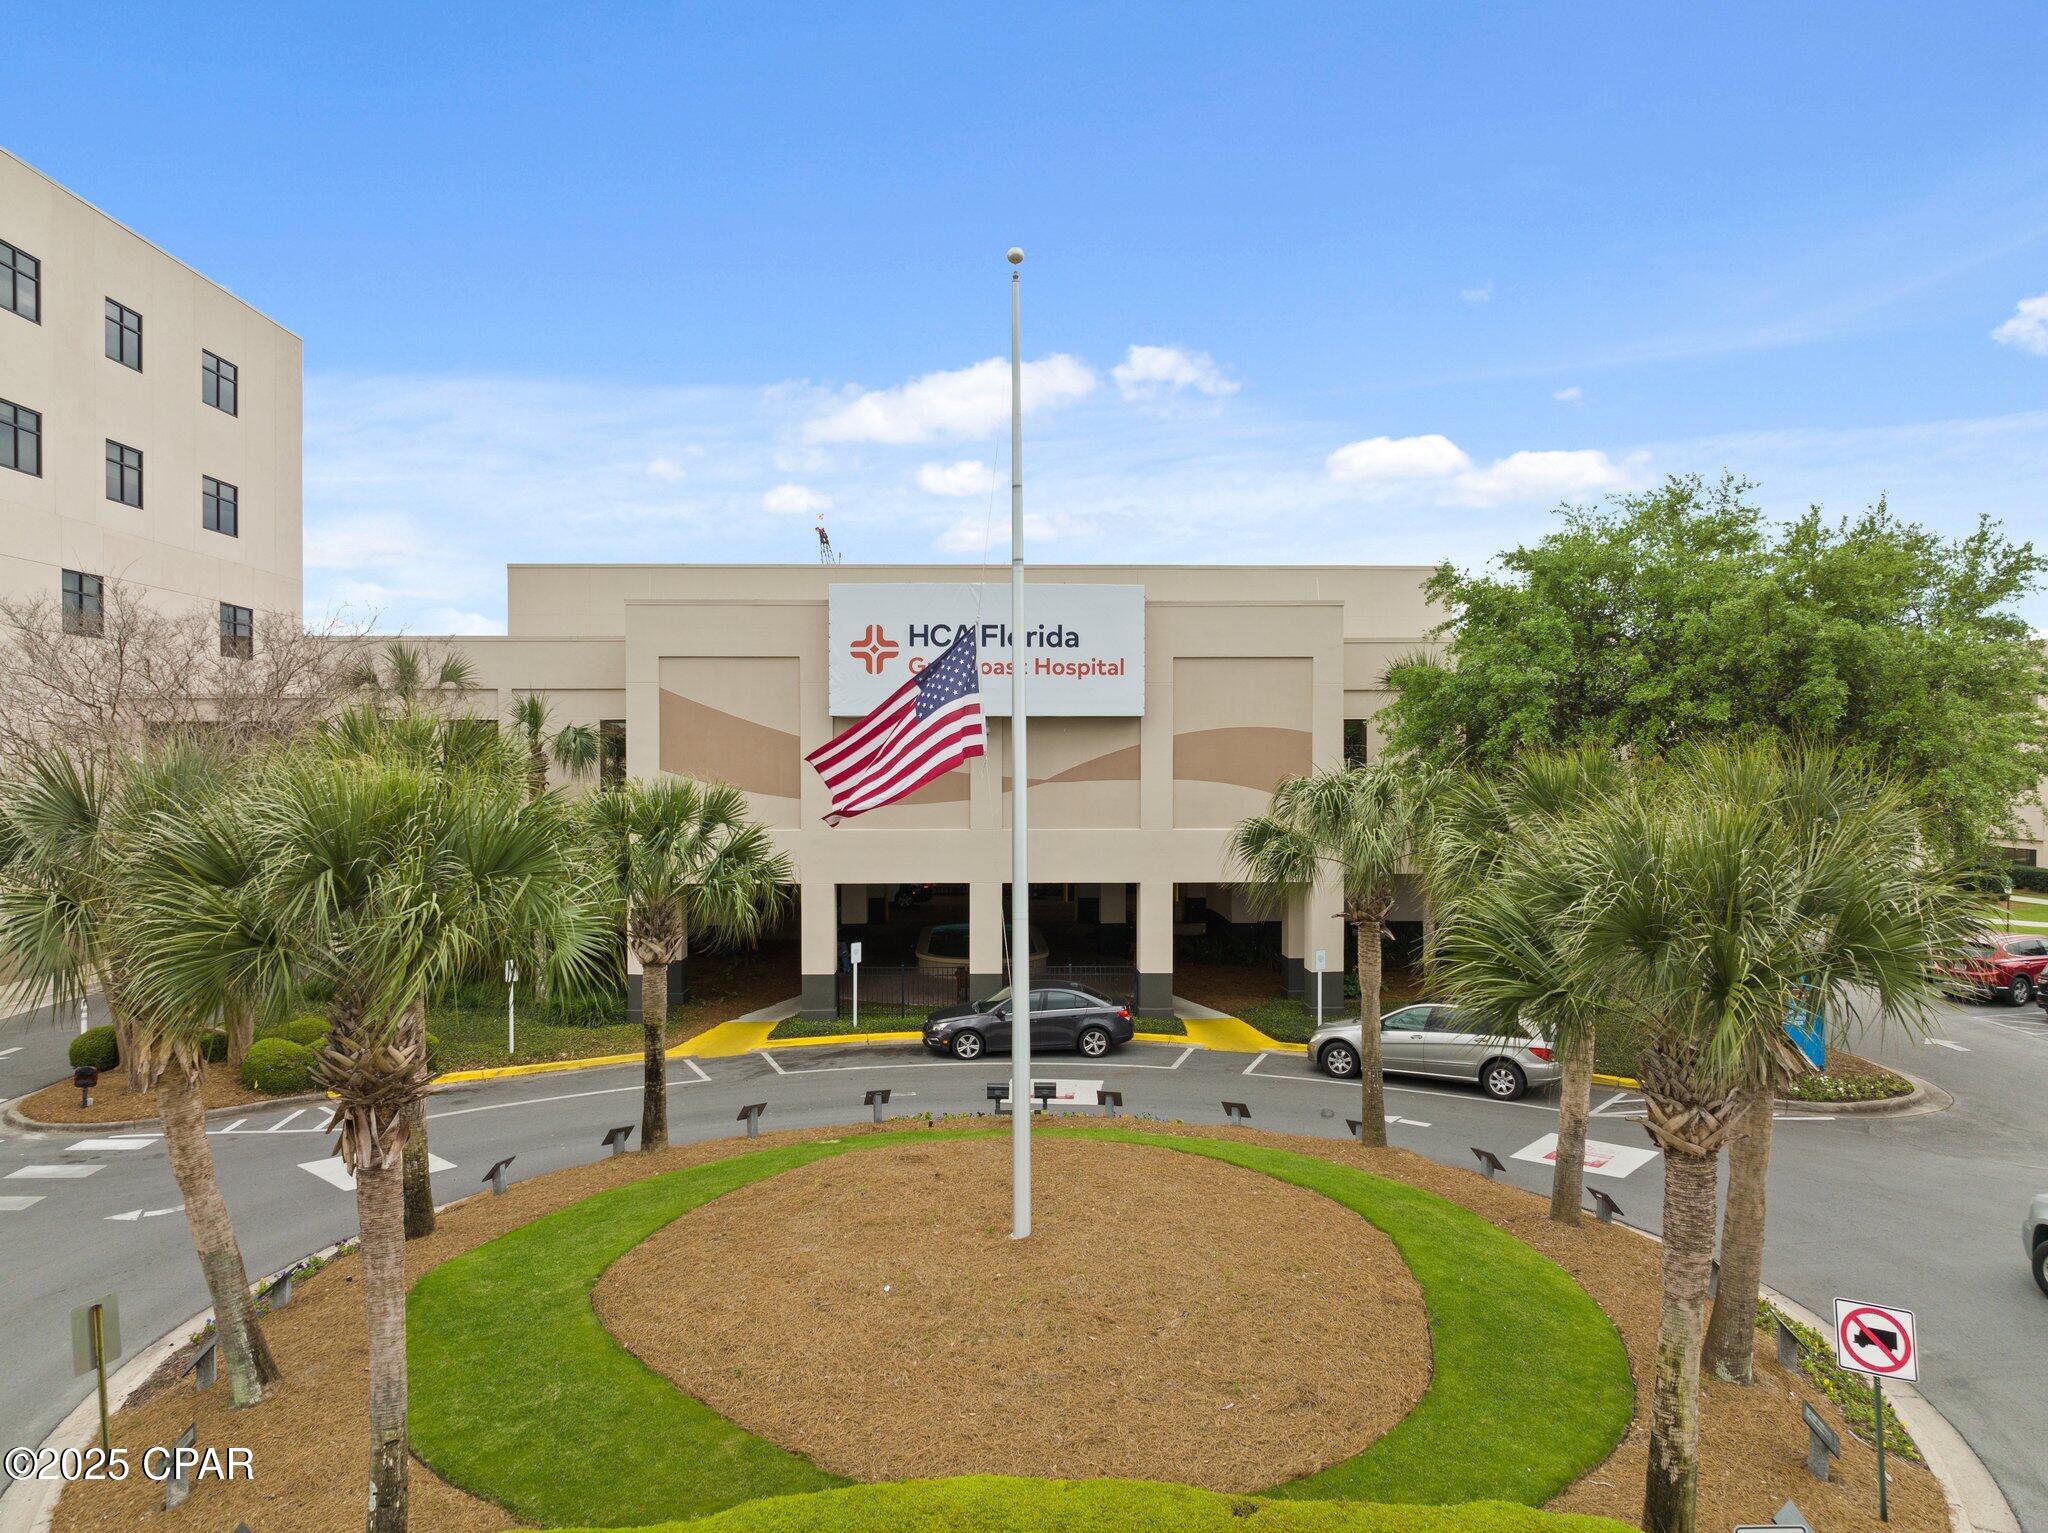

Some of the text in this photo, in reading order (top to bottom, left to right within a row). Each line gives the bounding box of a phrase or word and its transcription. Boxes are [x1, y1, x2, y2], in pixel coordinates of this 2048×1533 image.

[909, 624, 1079, 648] HCA Flrida
[1035, 658, 1124, 679] Hospital
